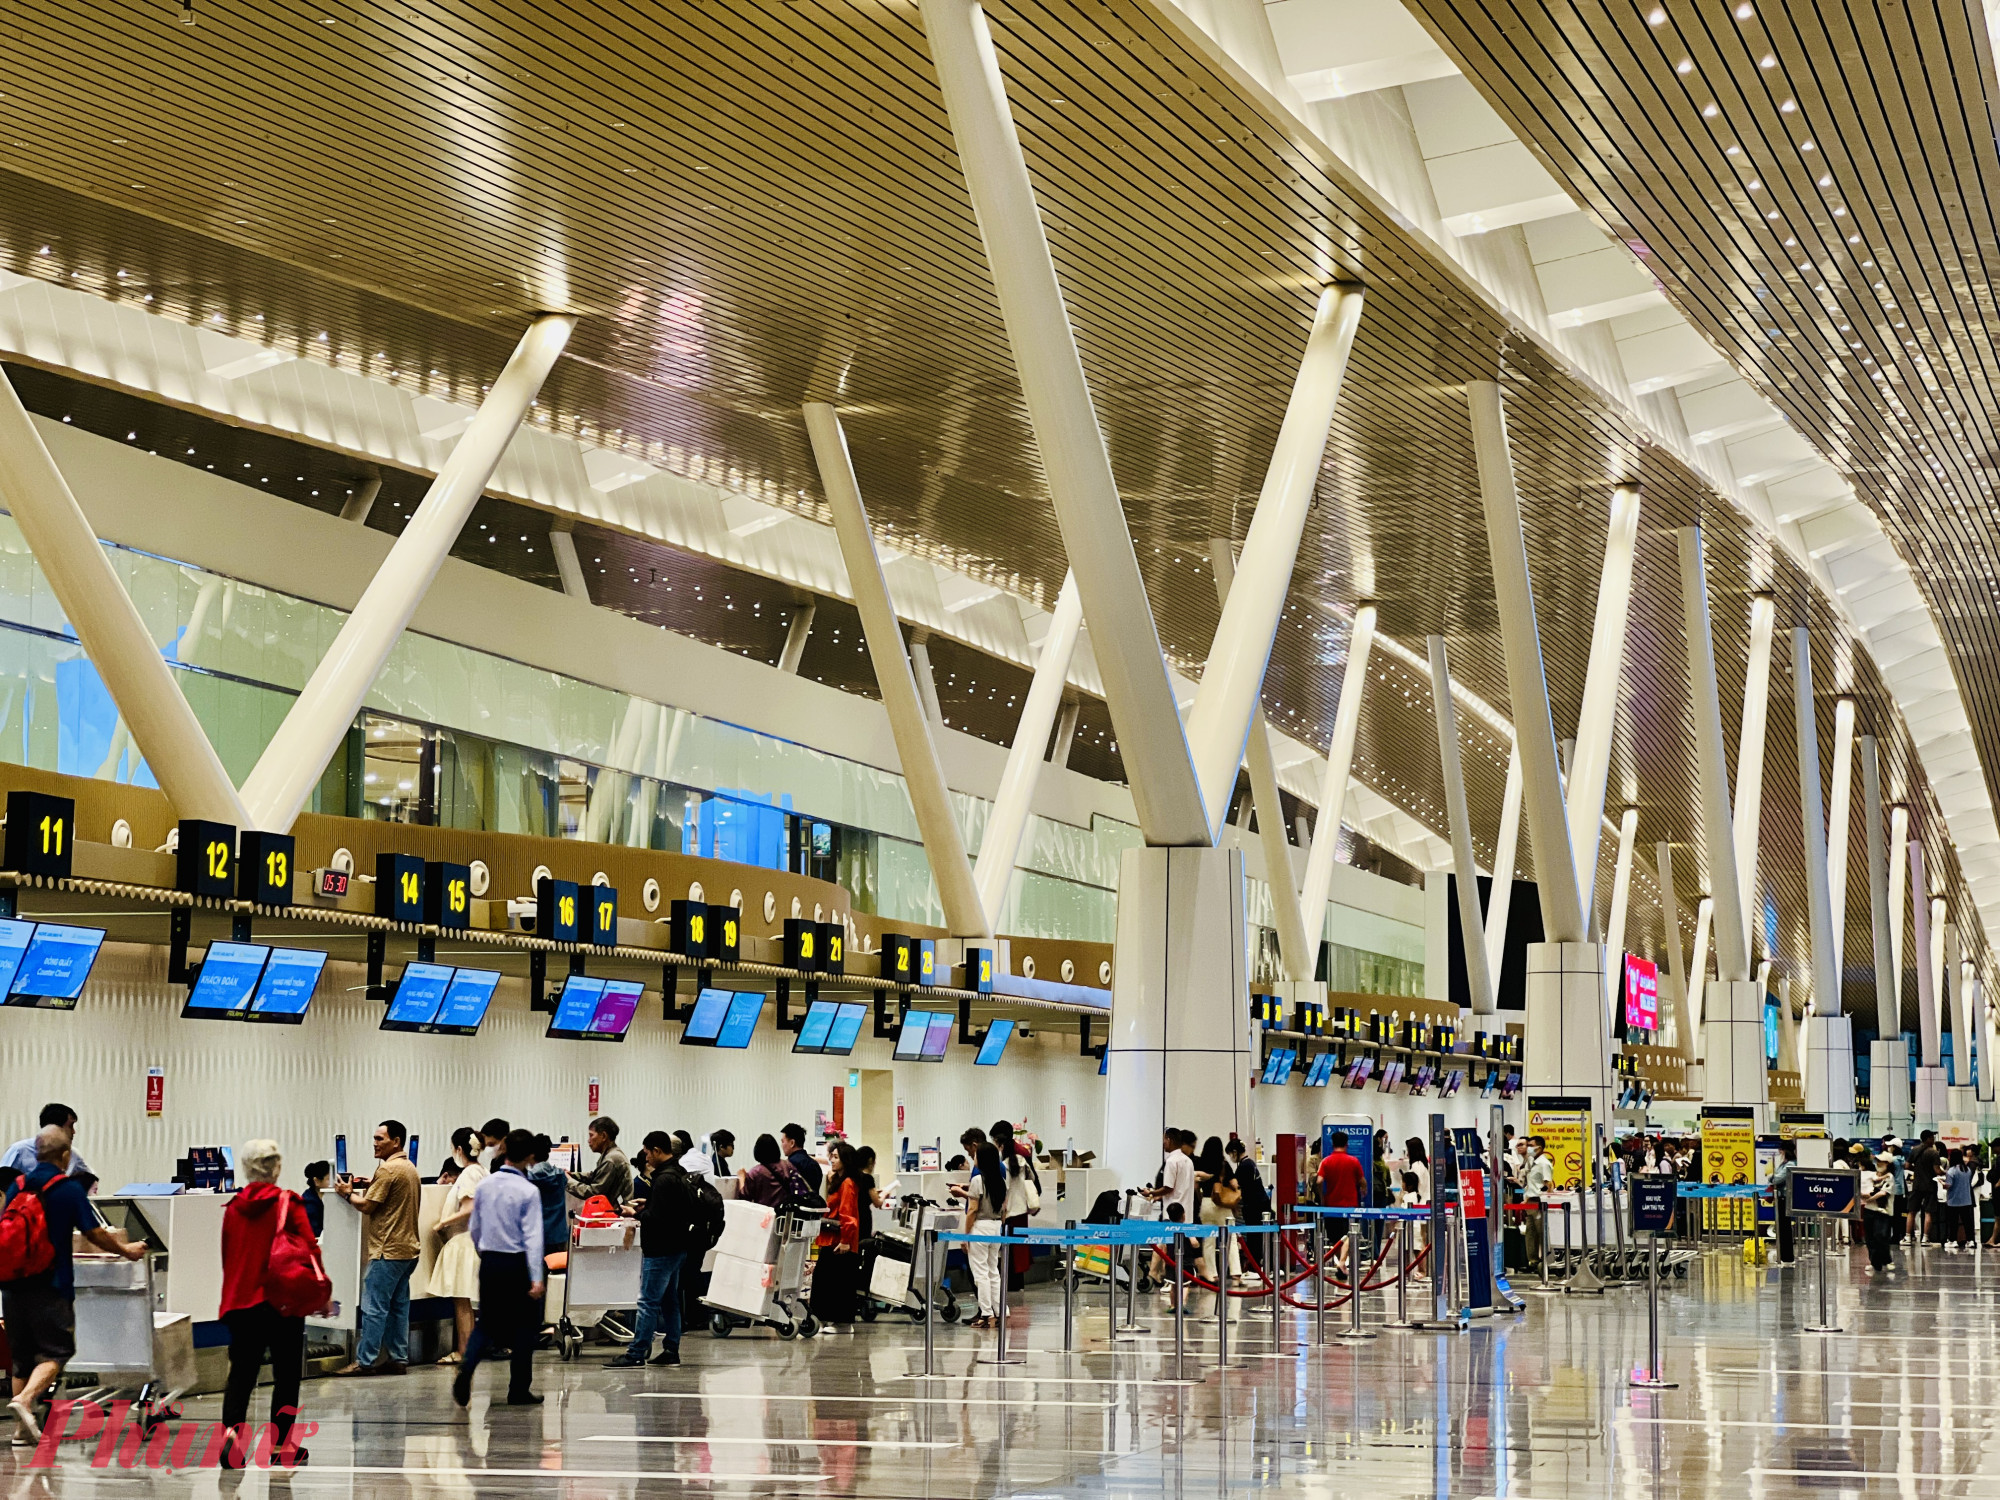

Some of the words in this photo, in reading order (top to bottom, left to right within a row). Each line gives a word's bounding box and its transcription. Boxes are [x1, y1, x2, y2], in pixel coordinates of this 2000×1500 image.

[40, 816, 63, 855] 11
[206, 841, 227, 878] 12
[267, 852, 286, 887] 13
[324, 874, 334, 891] 05
[336, 876, 346, 892] 30
[401, 872, 417, 905] 14
[449, 879, 465, 912] 15
[559, 897, 573, 926] 16
[599, 902, 611, 931] 17
[691, 915, 703, 944] 18
[724, 920, 736, 947] 19
[801, 932, 813, 957] 20
[831, 936, 841, 960] 21
[898, 947, 908, 970] 22
[923, 951, 932, 973] 23
[981, 960, 991, 981] 24
[200, 975, 221, 985] KHÁCH
[1338, 1127, 1370, 1136] VASCO
[1809, 1184, 1821, 1193] LỐI
